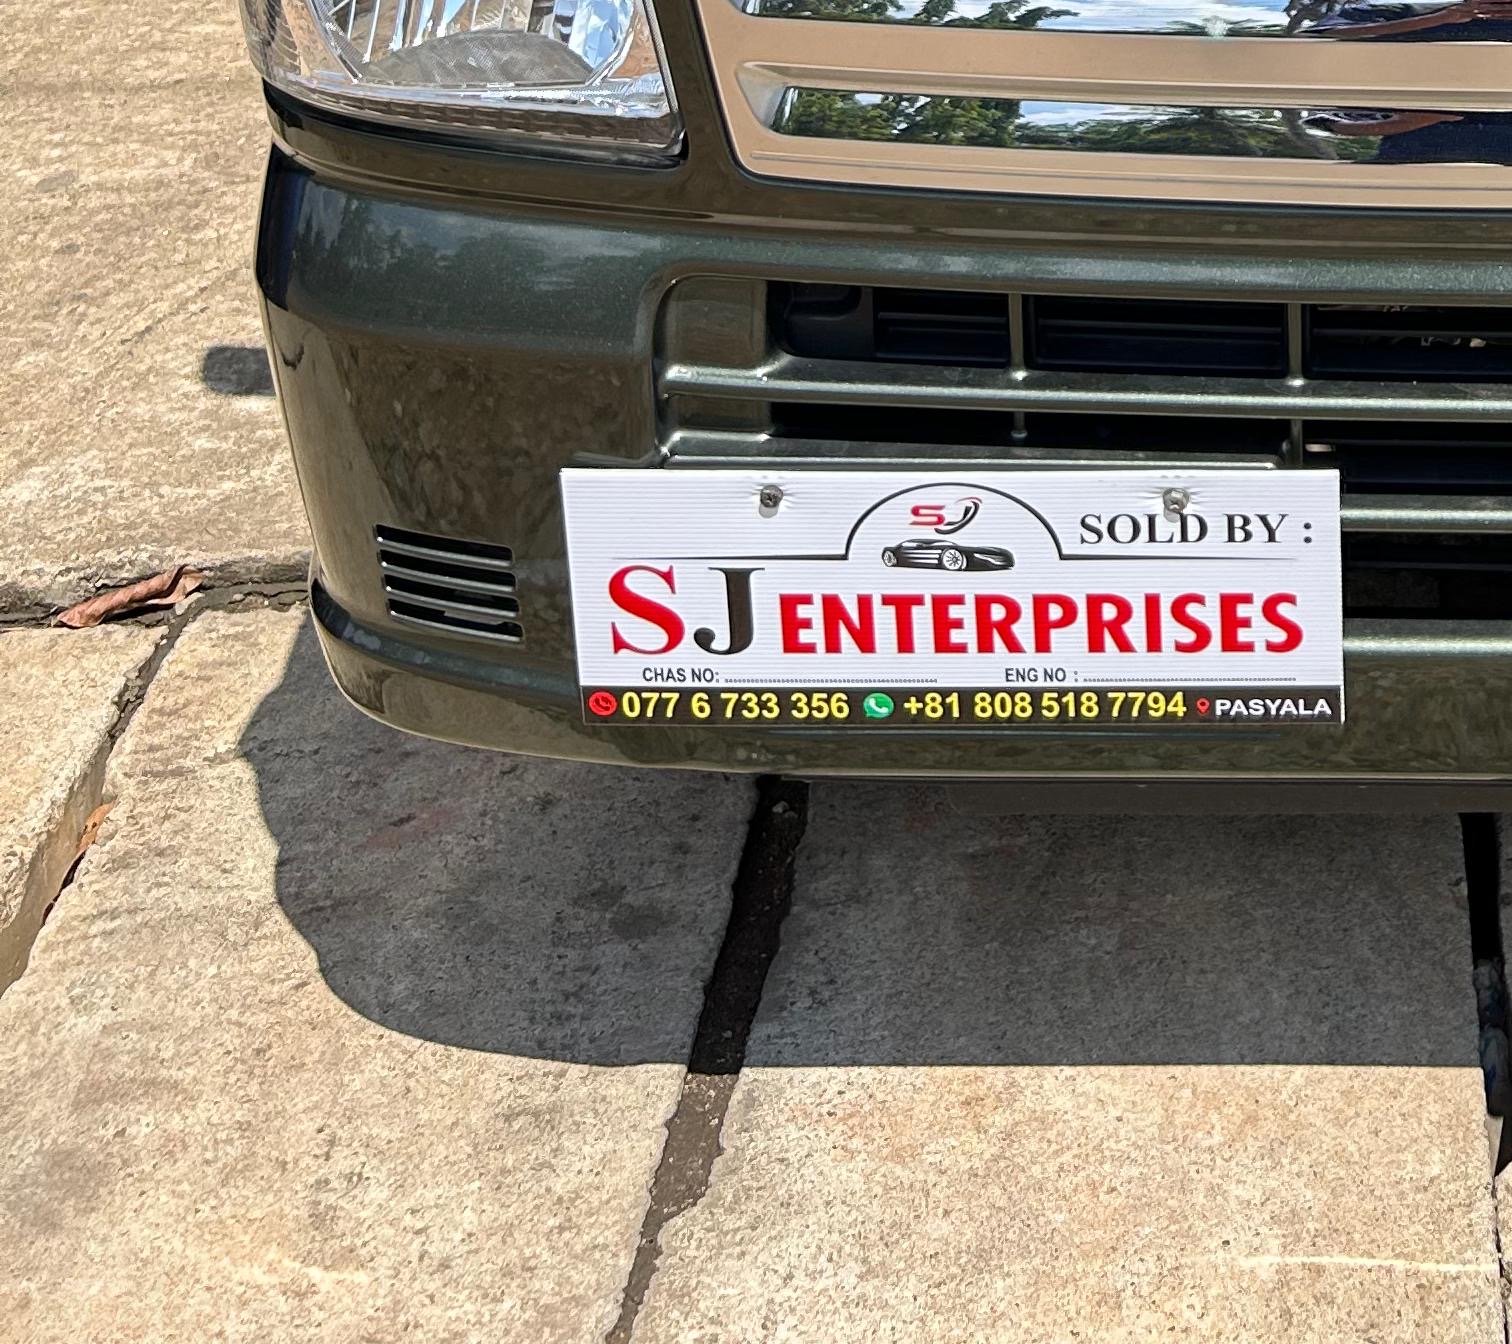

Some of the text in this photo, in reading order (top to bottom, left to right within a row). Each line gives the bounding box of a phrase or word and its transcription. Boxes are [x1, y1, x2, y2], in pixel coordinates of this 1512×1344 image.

[1079, 512, 1208, 545] SOLD
[607, 564, 1305, 656] SJ ENTERPRISES
[641, 667, 687, 683] CHAS
[1004, 667, 1038, 683] ENG
[621, 691, 850, 719] 077 6 733 356
[903, 691, 1187, 719] +81 808 518 7794
[1215, 698, 1332, 716] PASYALA
